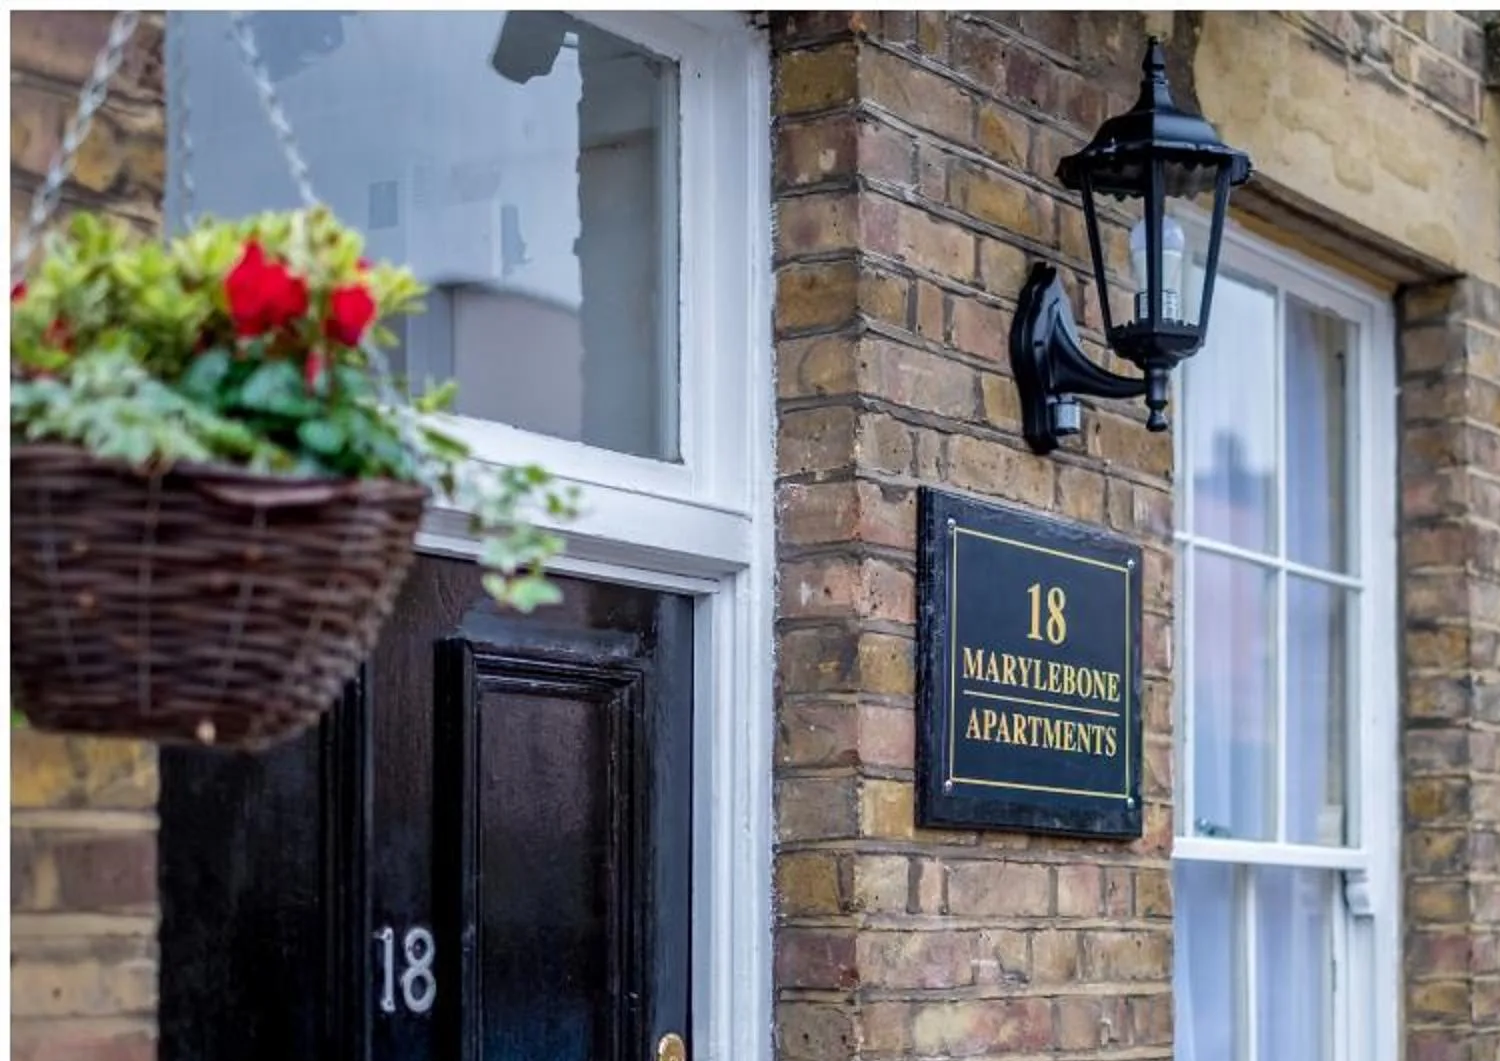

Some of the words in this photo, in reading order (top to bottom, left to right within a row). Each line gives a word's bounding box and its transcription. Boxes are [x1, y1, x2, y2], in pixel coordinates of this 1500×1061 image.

[1027, 583, 1067, 645] 18
[963, 647, 1120, 702] MARYLEBONE
[965, 707, 1117, 757] APARTMENTS
[371, 926, 437, 1013] 18
